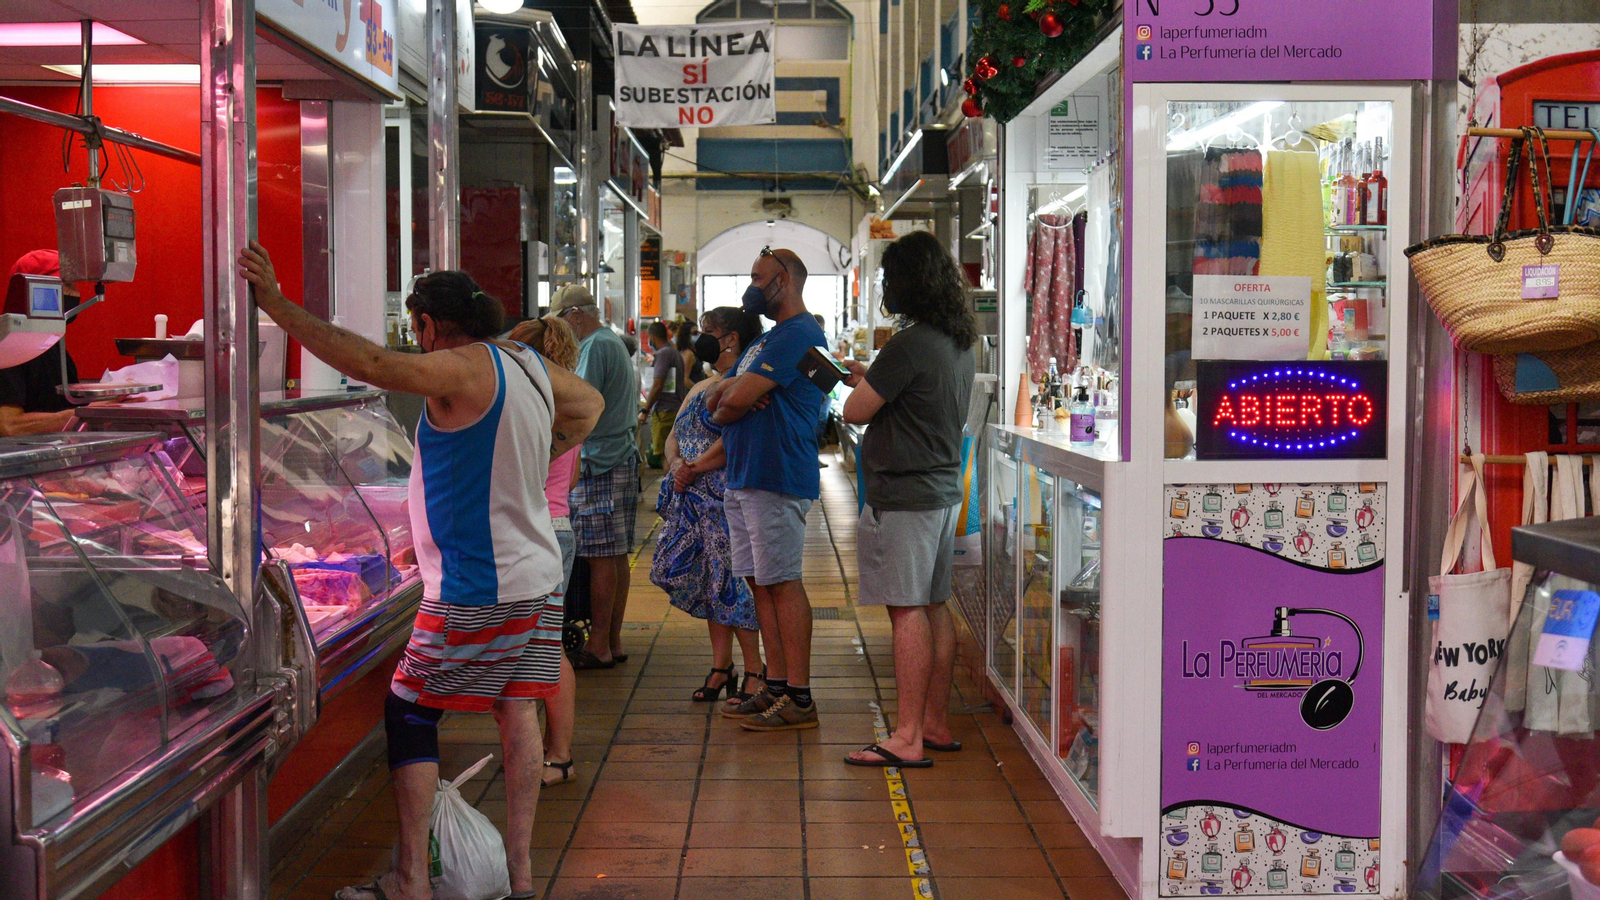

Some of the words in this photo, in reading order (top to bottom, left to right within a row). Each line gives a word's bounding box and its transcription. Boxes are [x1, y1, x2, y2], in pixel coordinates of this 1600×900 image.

[366, 18, 393, 66] 53-54
[1160, 25, 1267, 42] laperfumeriadm
[617, 31, 660, 57] LA
[668, 29, 770, 58] LÍNEA
[1160, 46, 1177, 59] La
[1180, 45, 1256, 59] Perfumería
[1260, 45, 1280, 58] del
[1284, 45, 1343, 58] Mercado
[682, 58, 709, 85] SÍ
[620, 79, 771, 104] SUBESTACIÓN
[678, 106, 714, 125] NO
[1234, 283, 1271, 292] OFERTA
[1211, 311, 1256, 321] PAQUETE
[1263, 312, 1269, 320] X
[1271, 312, 1292, 322] 2,80
[1294, 312, 1300, 320] €
[1202, 327, 1208, 335] 2
[1211, 327, 1260, 337] PAQUETES
[1262, 328, 1269, 336] X
[1271, 328, 1292, 338] 5,00
[1294, 328, 1300, 337] €
[1213, 394, 1374, 426] ABIERTO
[1182, 639, 1211, 679] La
[1206, 742, 1298, 755] laperfumeriadm
[1206, 759, 1221, 770] La
[1224, 758, 1287, 770] Perfumería
[1290, 758, 1308, 769] del
[1310, 757, 1360, 769] Mercado
